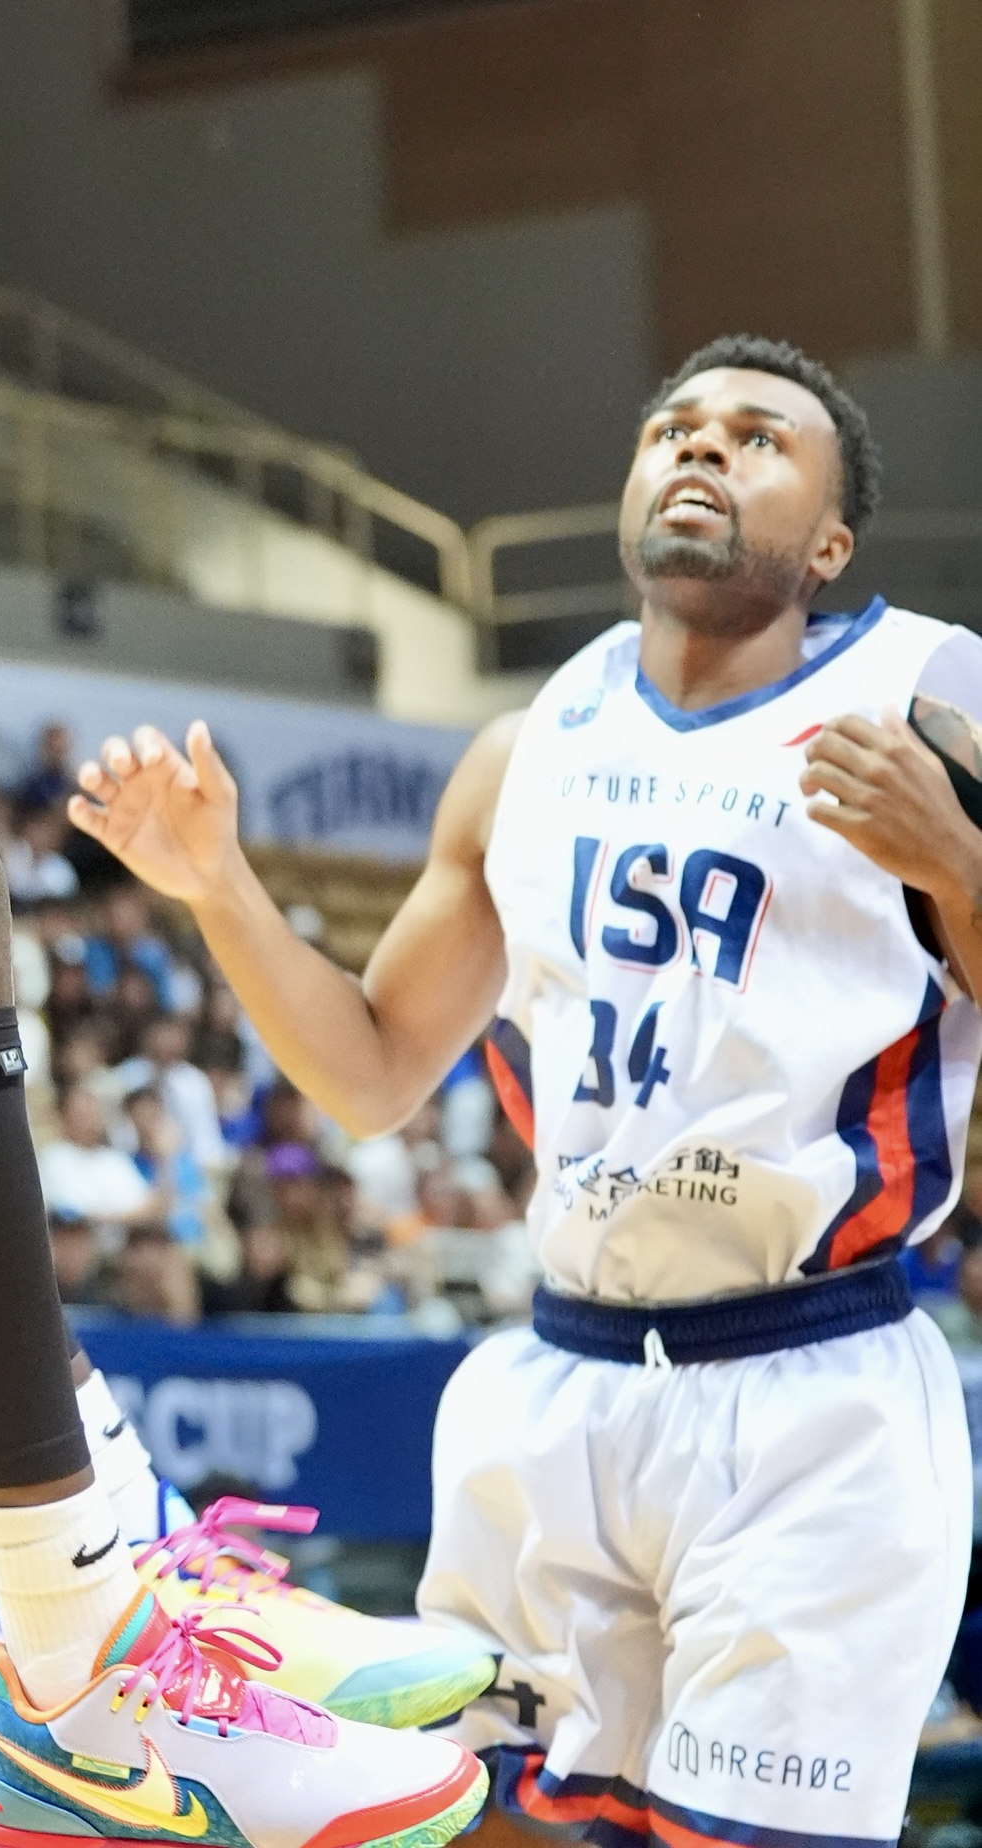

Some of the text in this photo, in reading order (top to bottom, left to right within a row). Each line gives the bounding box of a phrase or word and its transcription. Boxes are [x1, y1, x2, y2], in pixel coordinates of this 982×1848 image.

[553, 774, 791, 828] UTURE SPORT
[146, 1378, 317, 1490] CUP
